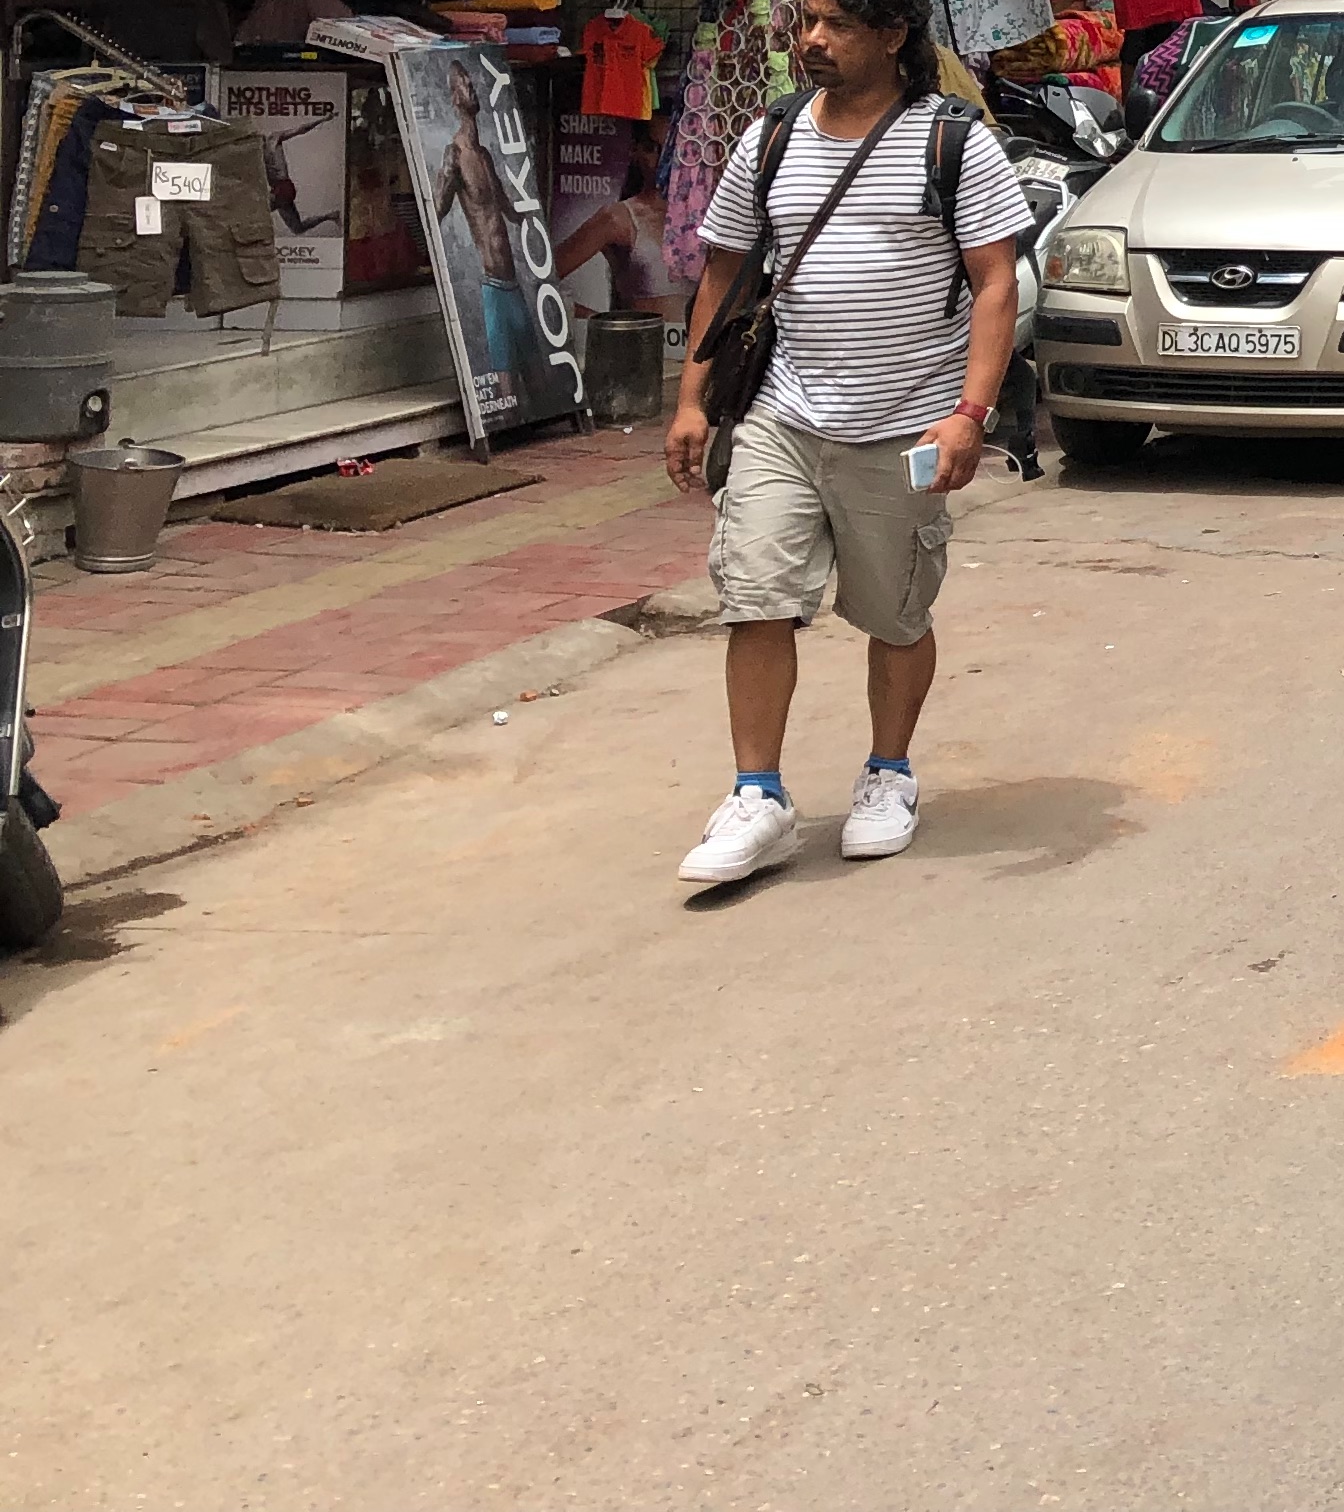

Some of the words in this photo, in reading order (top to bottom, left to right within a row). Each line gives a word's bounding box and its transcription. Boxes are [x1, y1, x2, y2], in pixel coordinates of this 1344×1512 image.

[226, 86, 312, 102] NOTHING
[226, 101, 265, 117] FITS
[560, 144, 602, 165] MAKE
[154, 166, 170, 184] Rs
[560, 174, 611, 195] MOODS
[480, 53, 584, 404] JOCKEY
[276, 245, 316, 257] CKEY
[1245, 333, 1296, 355] 5975
